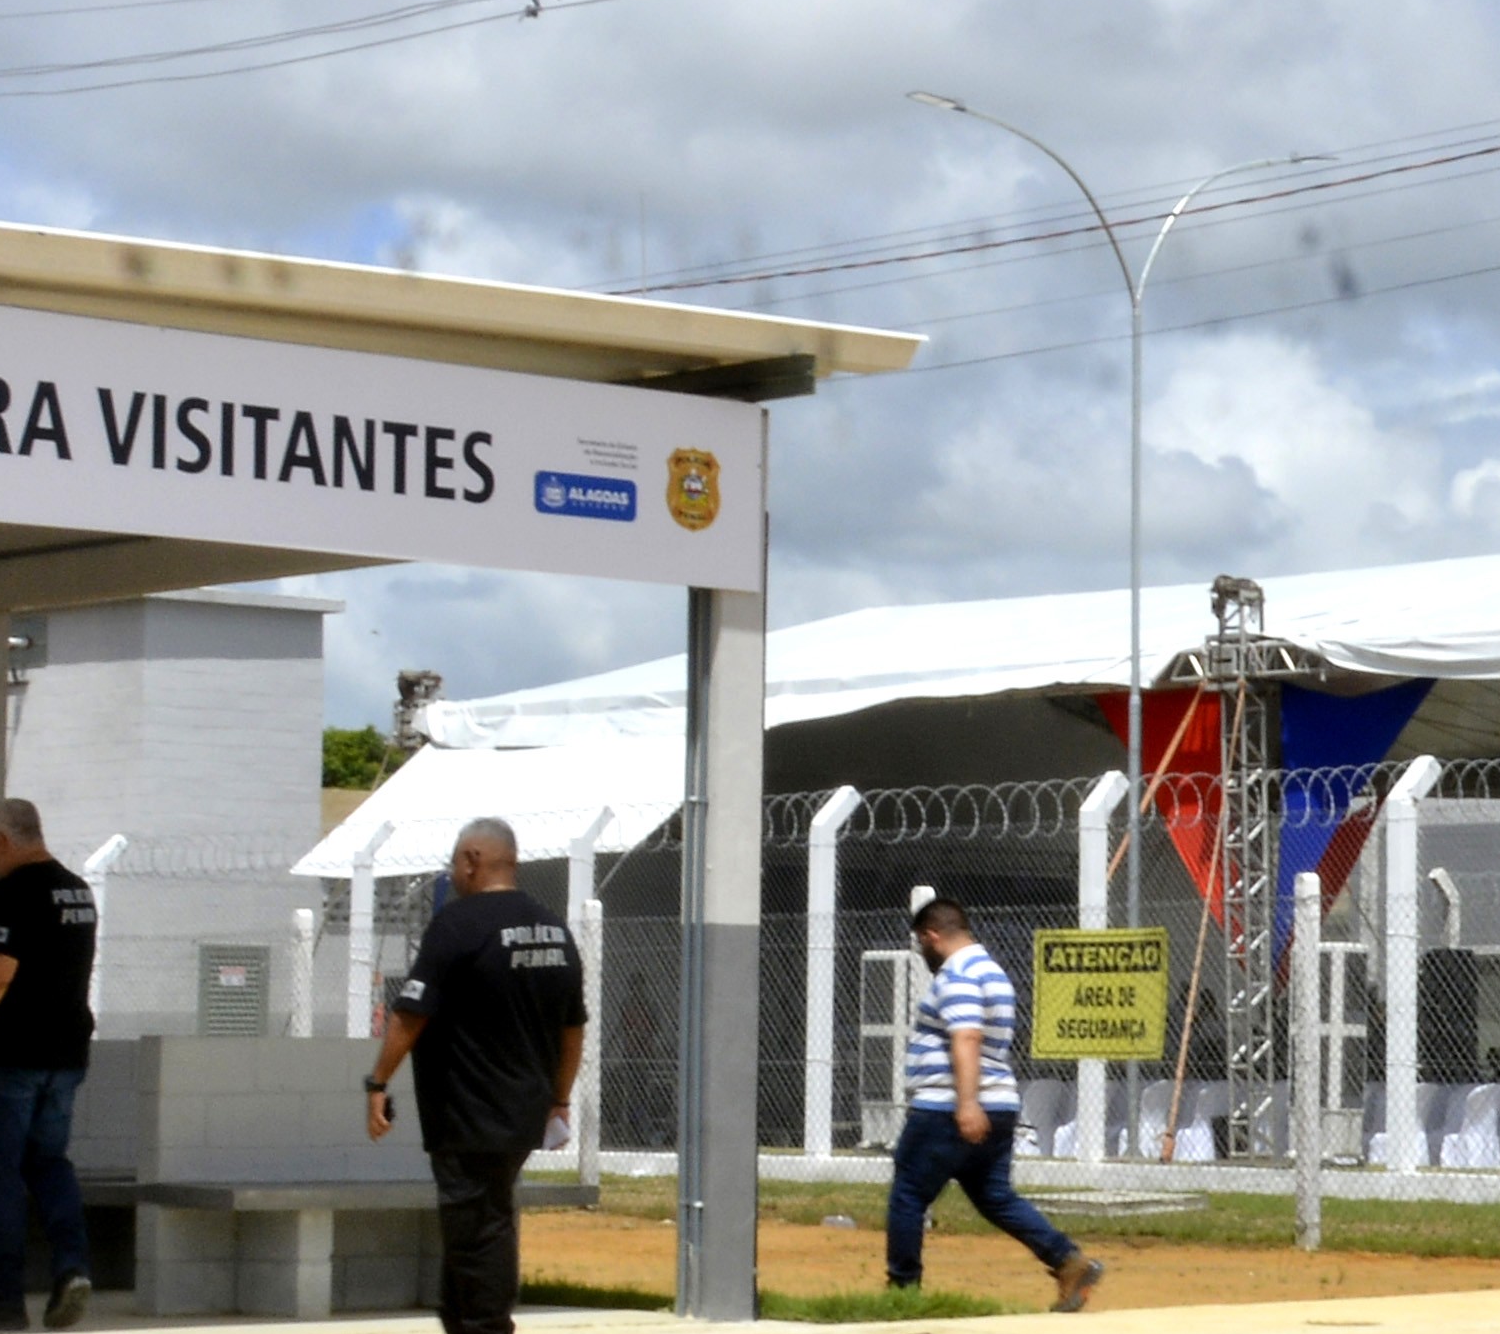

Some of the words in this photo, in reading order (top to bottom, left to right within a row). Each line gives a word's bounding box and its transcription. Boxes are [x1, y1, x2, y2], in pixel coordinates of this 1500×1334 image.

[97, 387, 495, 504] VISITANTES
[569, 487, 629, 505] ALAGOAS
[1074, 983, 1114, 1007] ÁREA
[1118, 987, 1136, 1007] DE
[1056, 1019, 1146, 1045] SEGURANÇA
